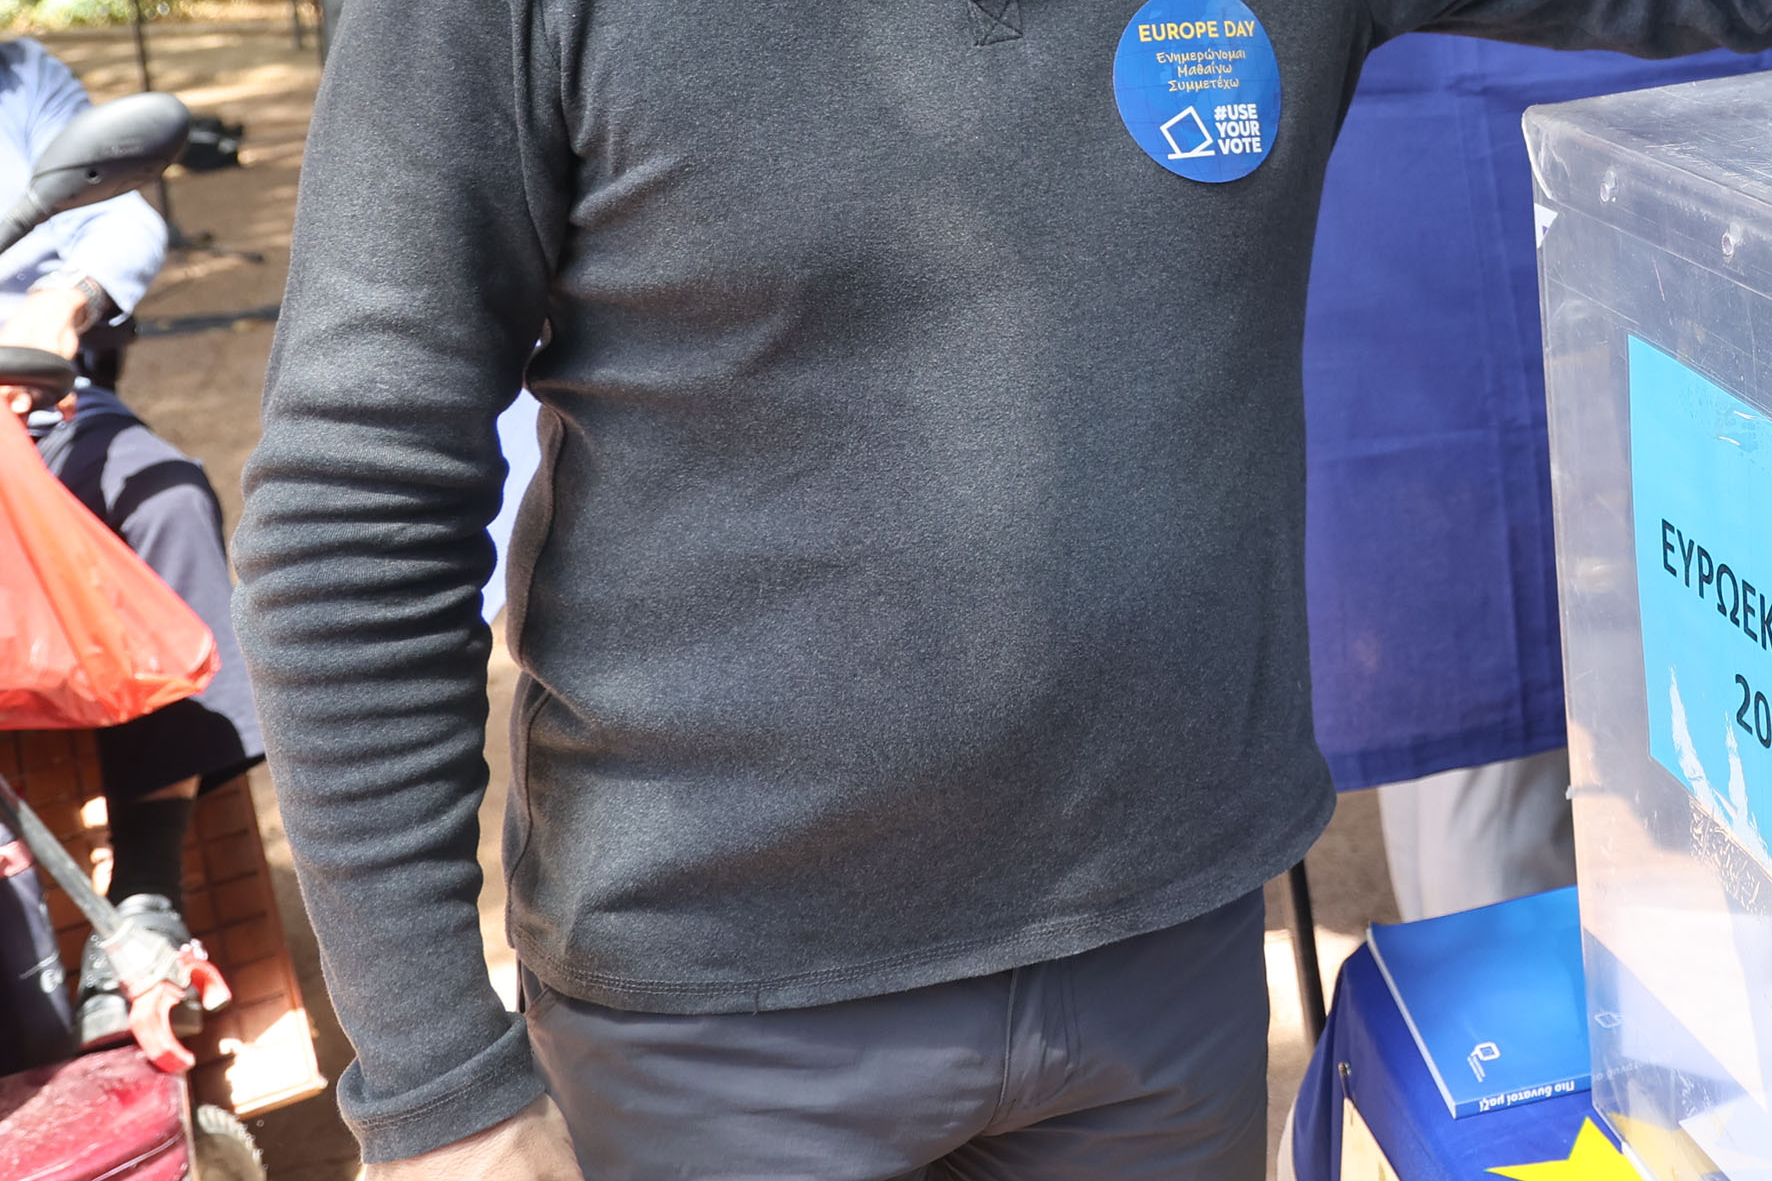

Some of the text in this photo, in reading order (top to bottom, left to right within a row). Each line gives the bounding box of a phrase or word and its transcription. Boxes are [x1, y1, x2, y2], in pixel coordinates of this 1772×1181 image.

[1138, 20, 1256, 42] EUROPE DAY
[1156, 48, 1246, 64] Ενημερώνομαι
[1177, 61, 1233, 78] Μαθαίνω
[1167, 75, 1240, 93] Συμμετέχω
[1214, 103, 1258, 120] #USE
[1215, 120, 1261, 138] YOUR
[1217, 137, 1262, 155] VOTE
[1479, 1080, 1575, 1112] Πιο δυνατοί μαζί
